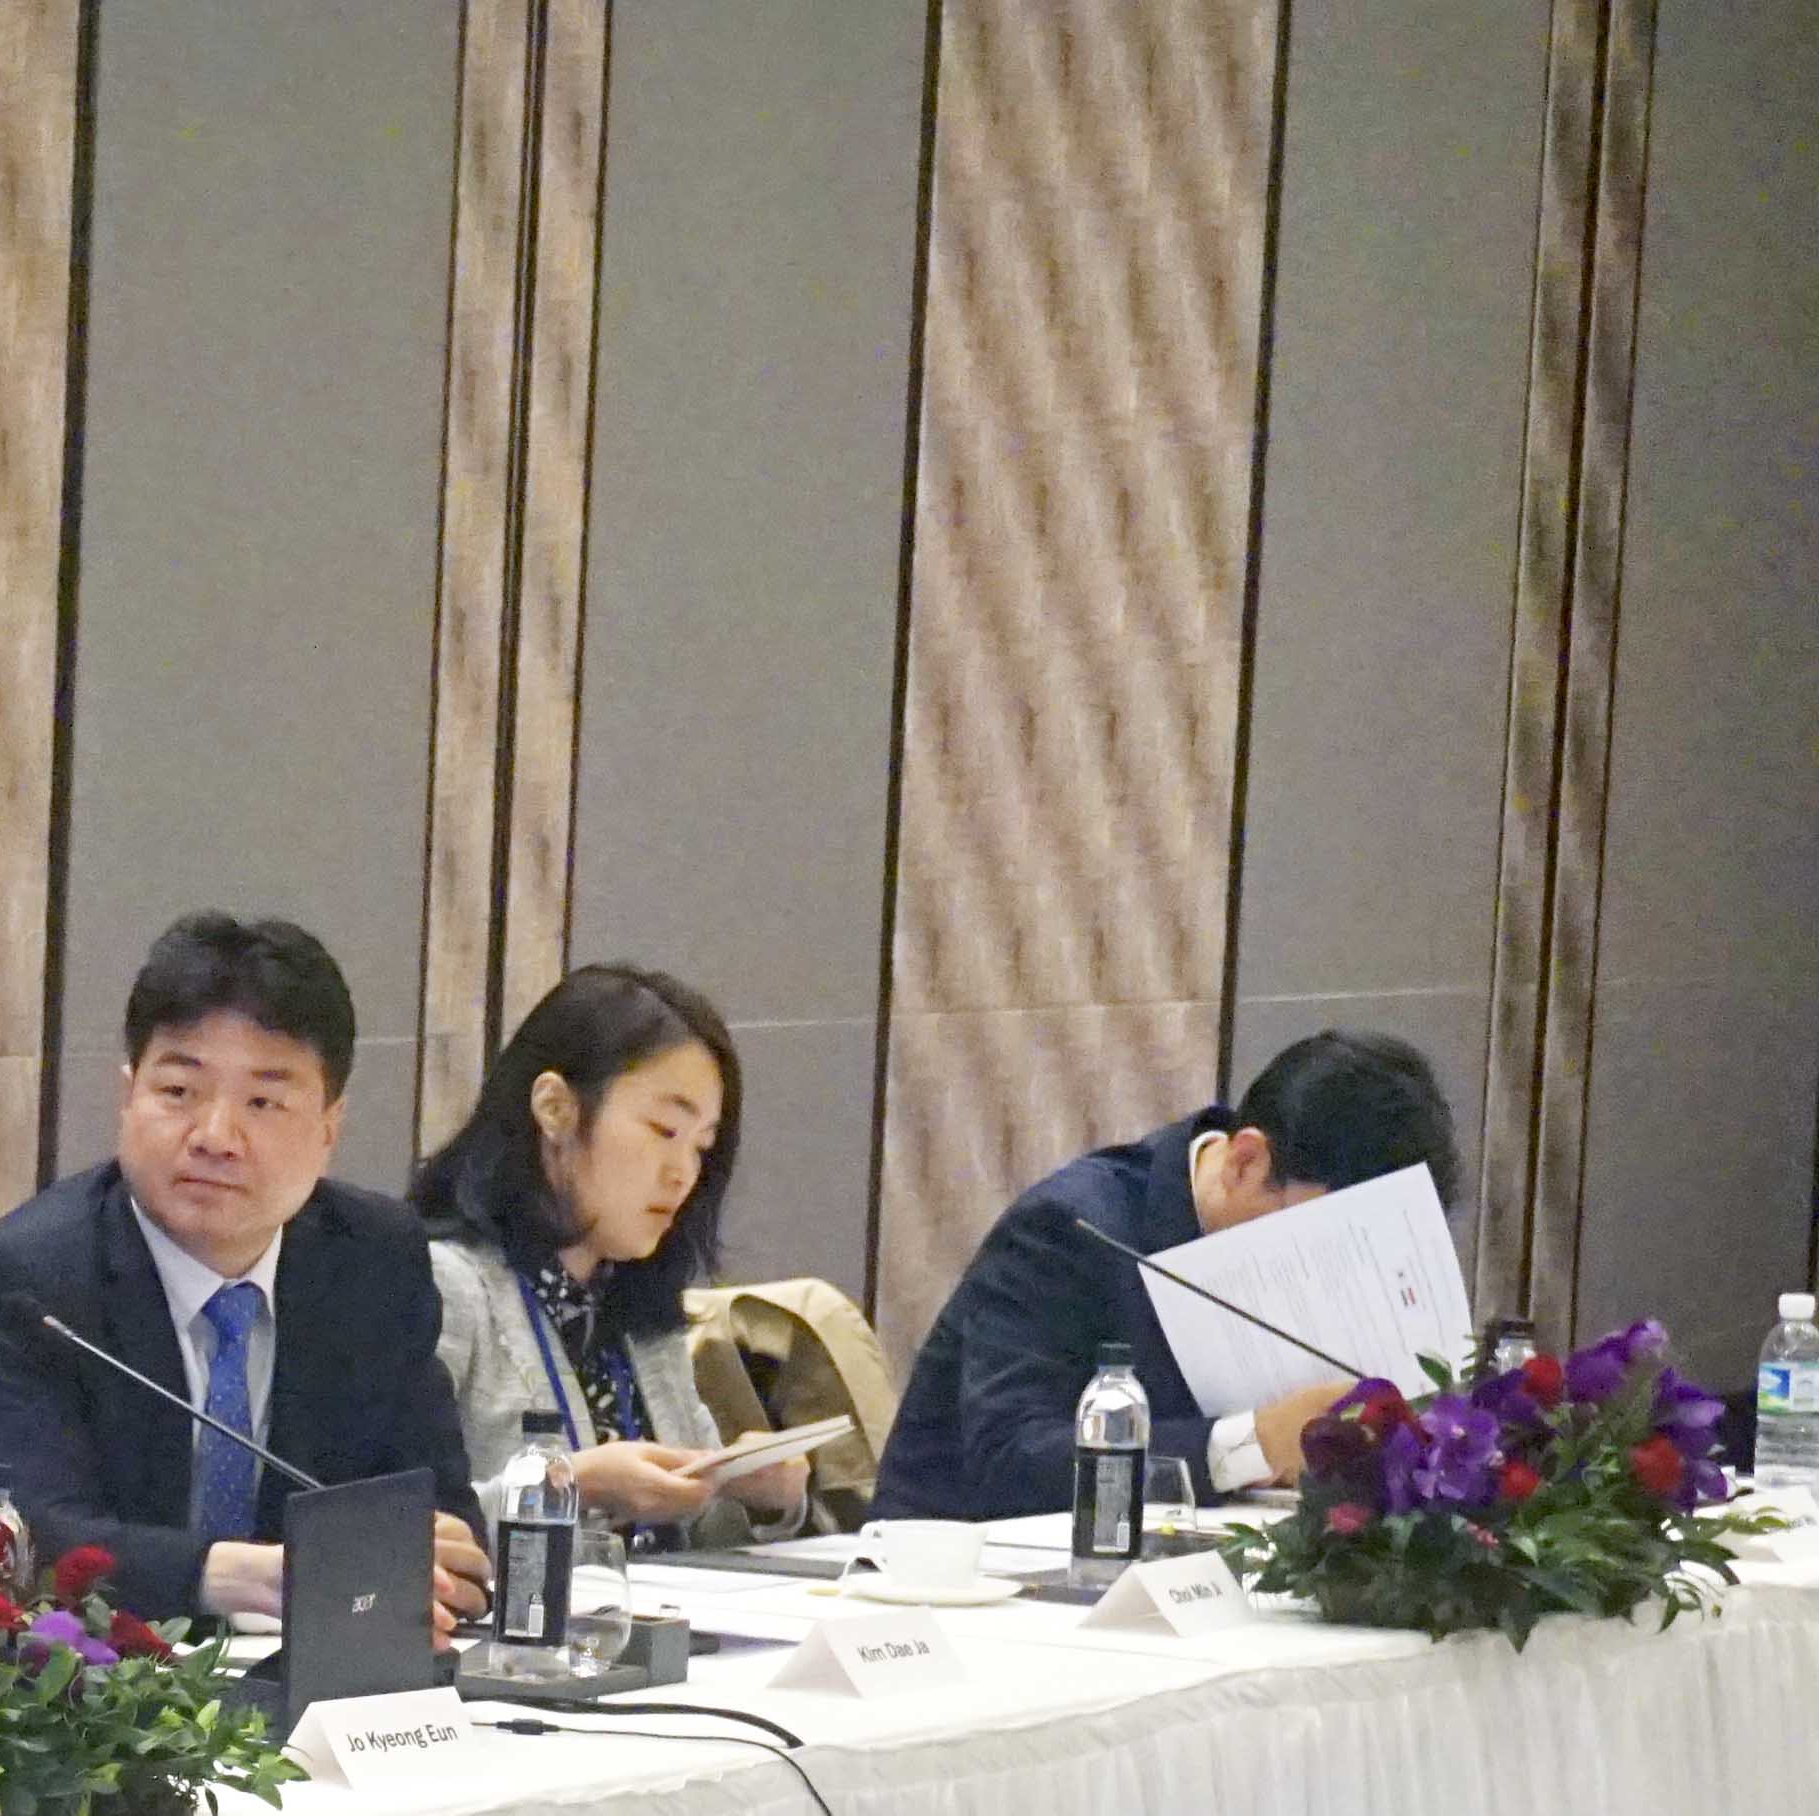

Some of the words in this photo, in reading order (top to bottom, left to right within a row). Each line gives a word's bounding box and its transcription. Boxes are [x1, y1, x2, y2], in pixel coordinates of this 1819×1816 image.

[857, 1646, 887, 1663] Kim
[884, 1641, 914, 1658] Dae
[347, 1733, 366, 1753] Jo
[365, 1727, 428, 1753] Kyeong
[424, 1723, 459, 1742] Eun
